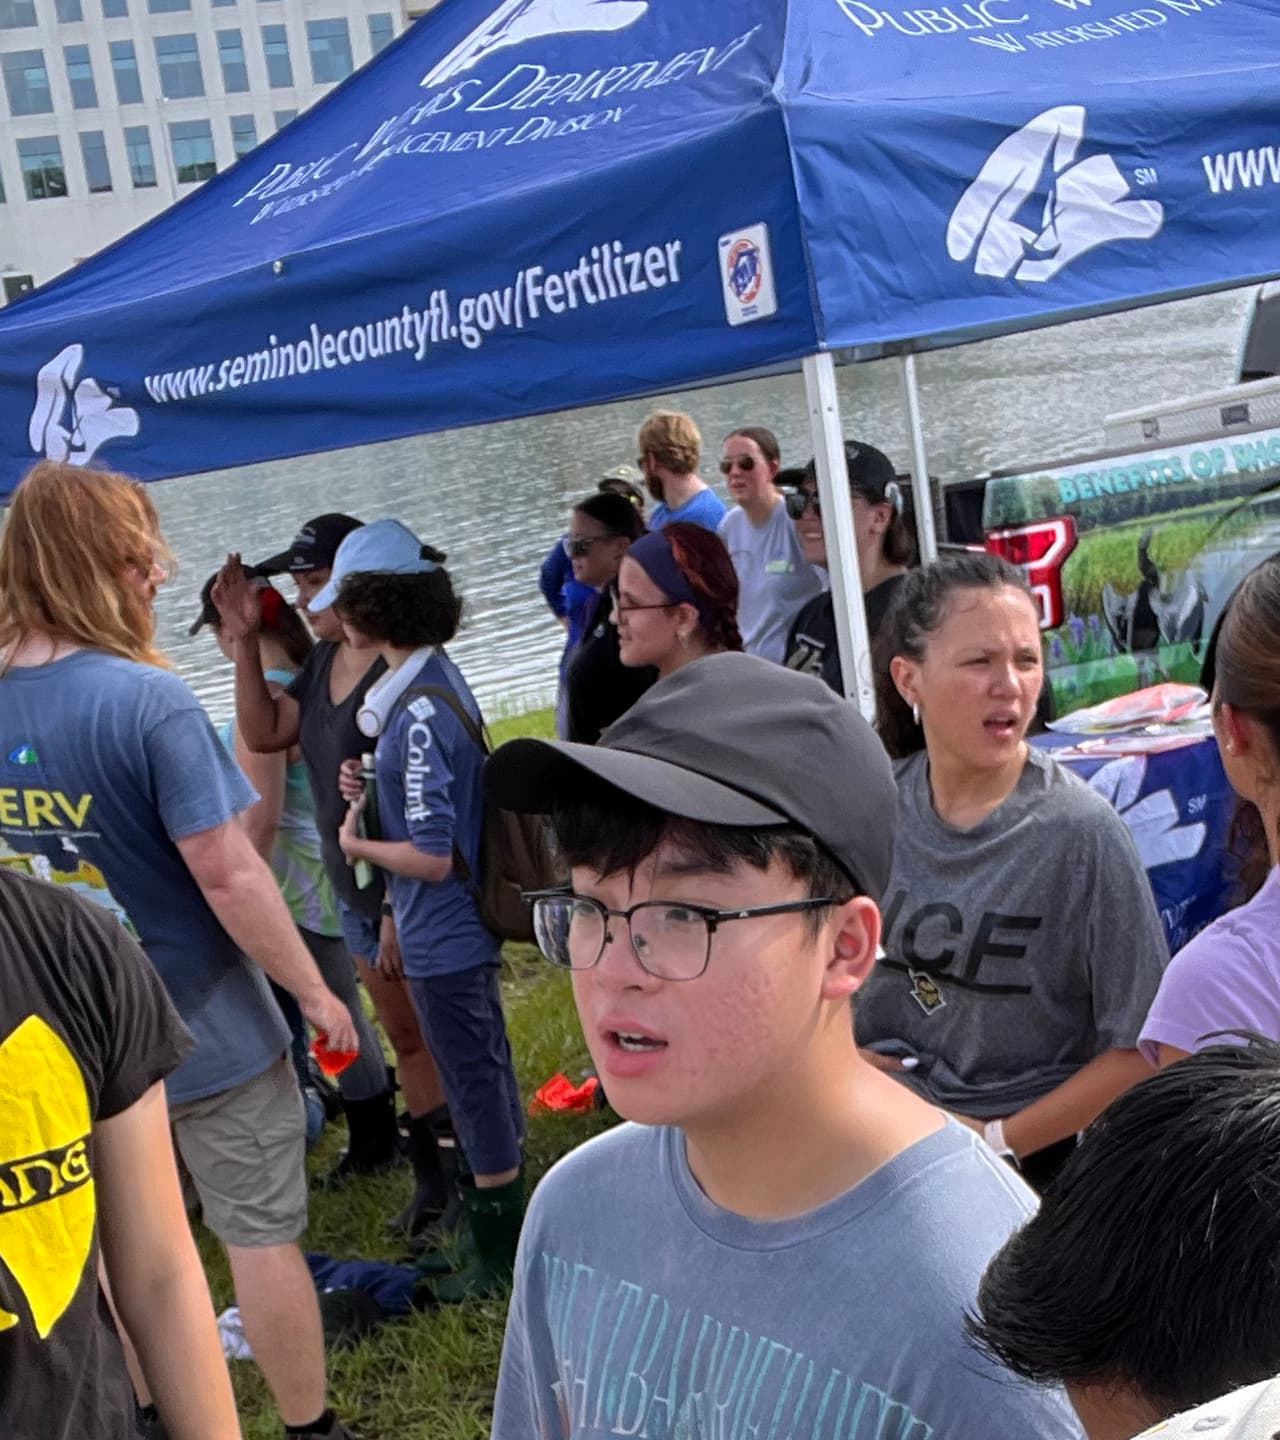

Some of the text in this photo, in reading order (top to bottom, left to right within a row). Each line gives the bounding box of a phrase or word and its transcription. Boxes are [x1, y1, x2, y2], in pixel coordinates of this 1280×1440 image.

[968, 9, 1167, 53] WATERSHED
[465, 24, 763, 112] DEPARTMENT
[144, 236, 683, 405] www.seminolecountyfl.gov/Fertilizer
[1058, 453, 1187, 504] BENEFITS
[1189, 447, 1226, 479] OF
